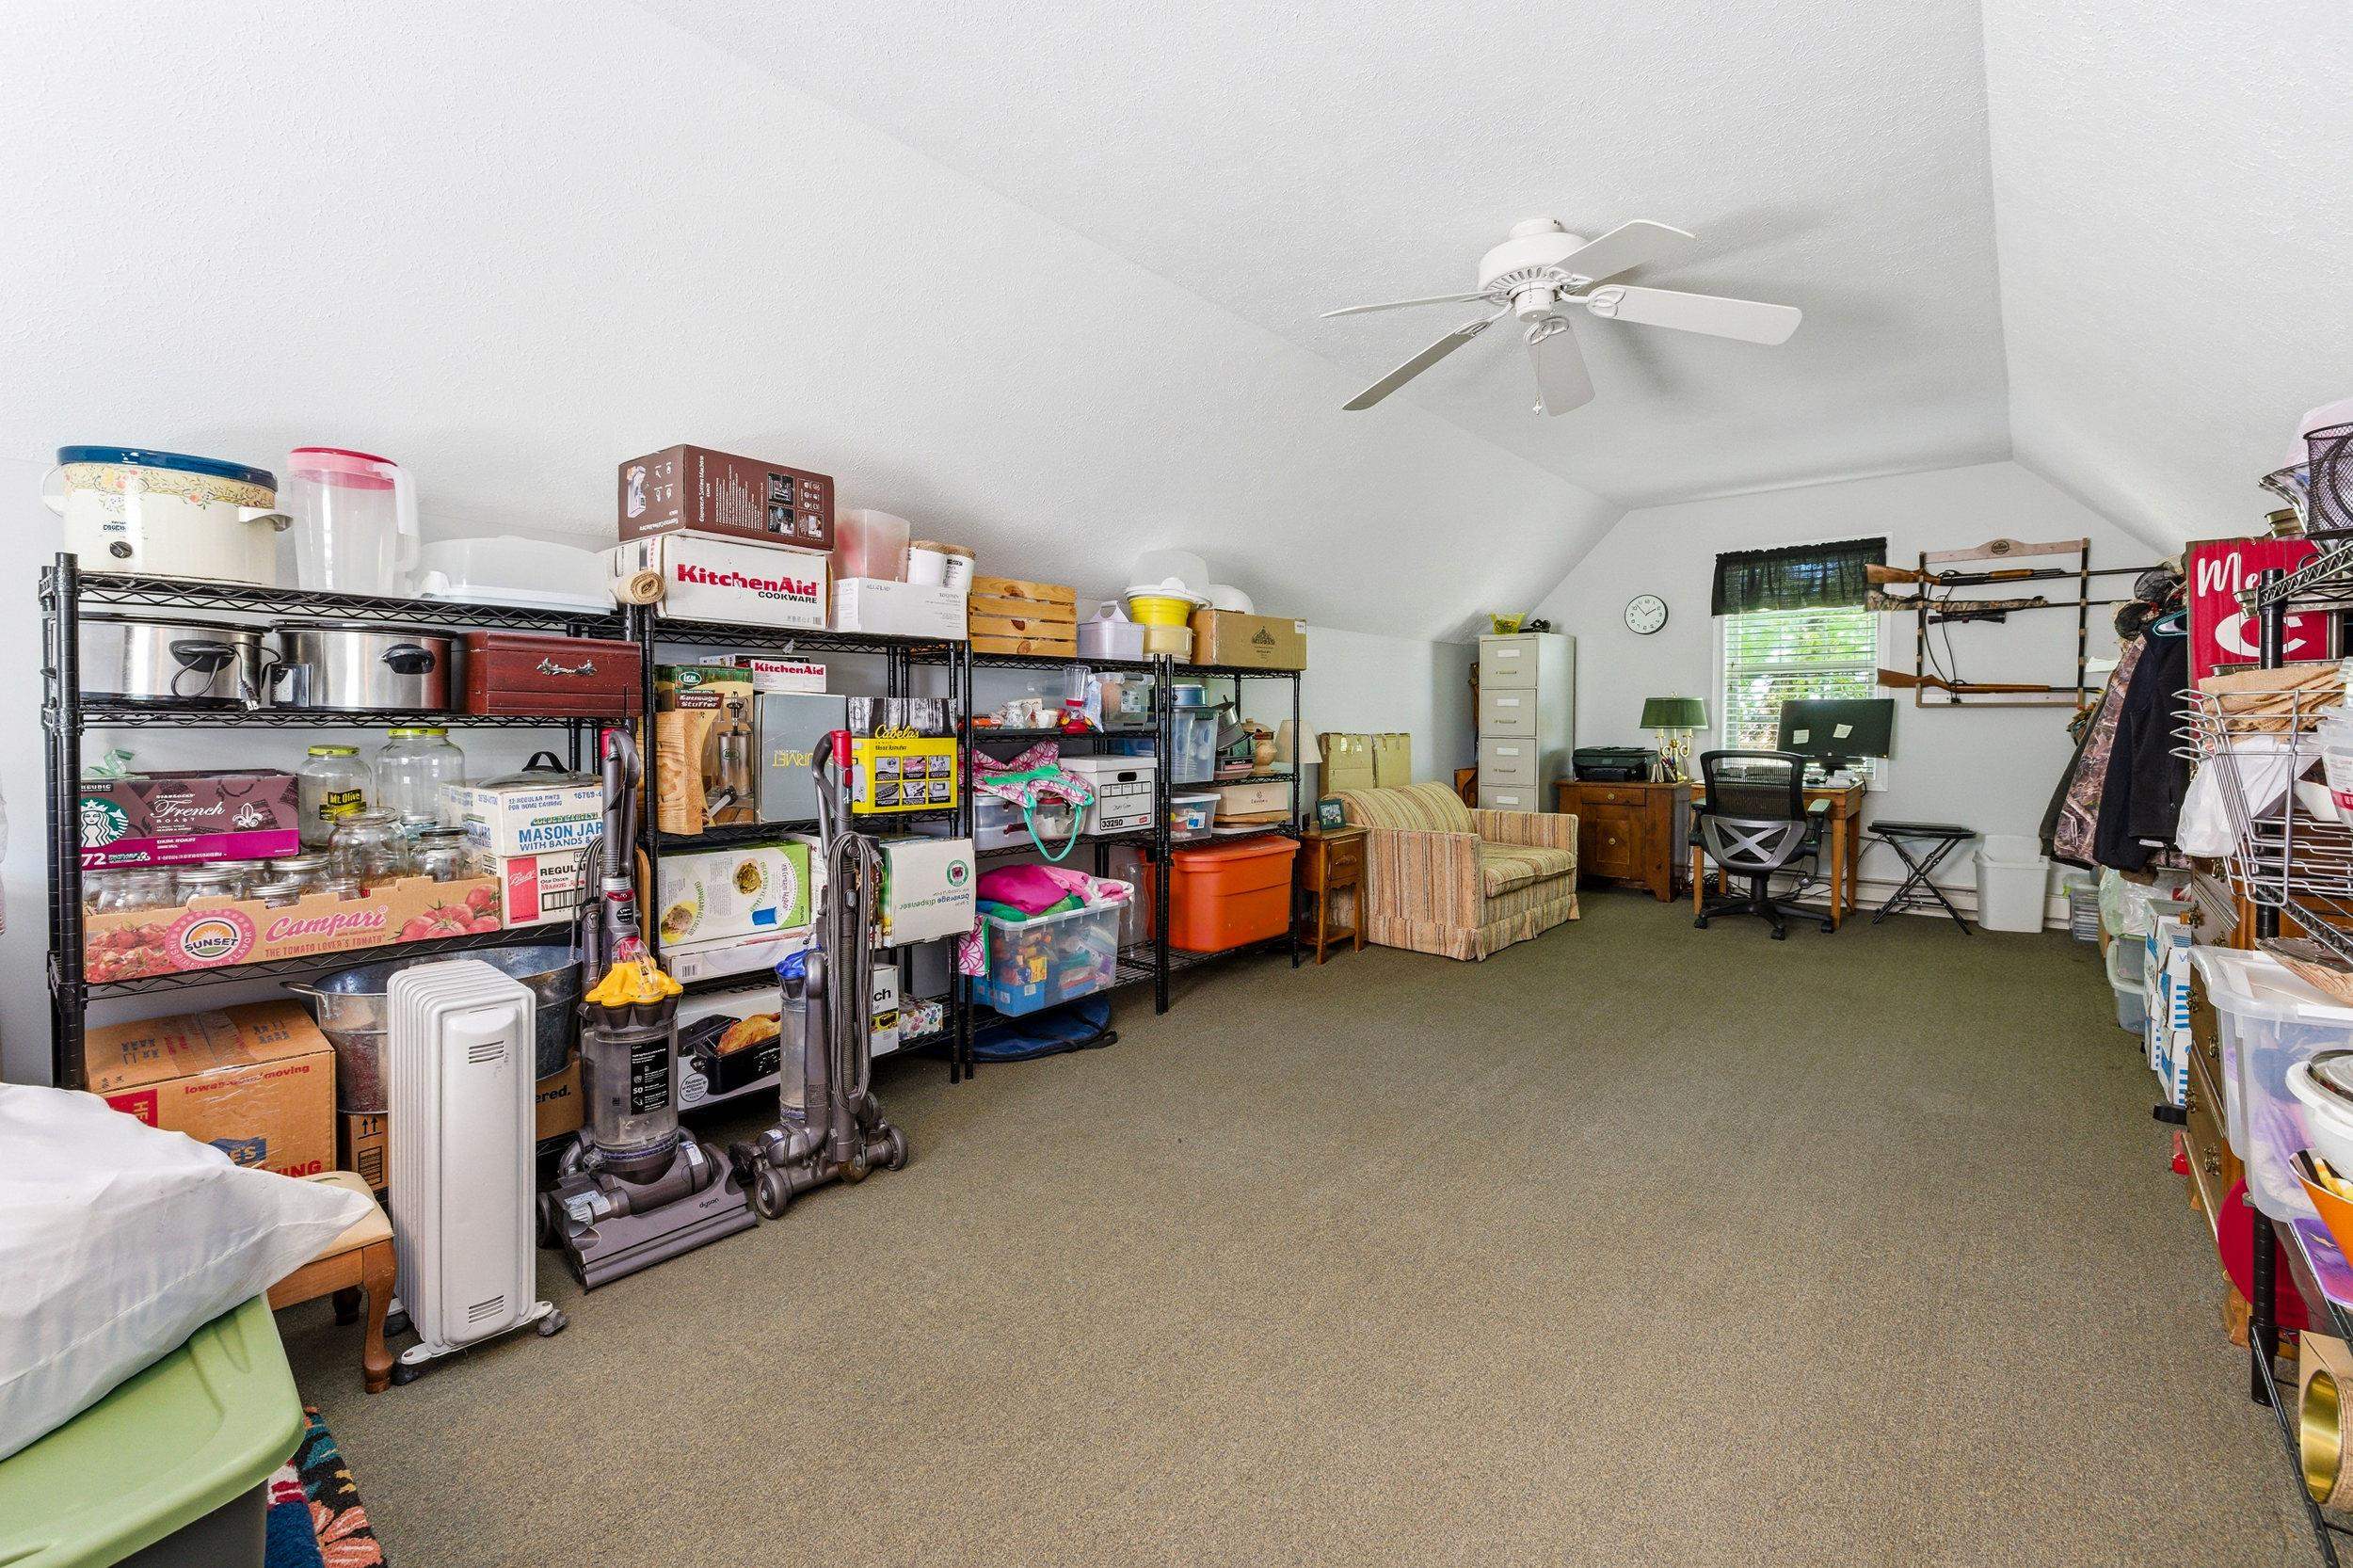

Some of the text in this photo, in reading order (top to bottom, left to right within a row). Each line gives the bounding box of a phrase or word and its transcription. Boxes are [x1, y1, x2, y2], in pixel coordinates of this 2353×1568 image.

[678, 563, 817, 598] KitchenAid
[758, 590, 817, 605] COOKWARE
[754, 662, 825, 675] KitchenAid
[874, 723, 920, 739] Cabela's
[342, 792, 360, 804] Olive
[150, 799, 226, 819] French
[519, 821, 604, 844] MASON JAR
[520, 840, 547, 853] WITH
[549, 836, 584, 848] BANDS
[81, 852, 106, 868] 72
[509, 871, 537, 887] Ball
[899, 898, 936, 910] dispenser
[264, 909, 384, 943] Campari
[184, 936, 239, 952] SUNSET
[264, 948, 280, 958] THE
[282, 943, 315, 955] TOMATO
[352, 934, 384, 948] TOMATO
[872, 988, 892, 1002] ch
[536, 1084, 571, 1103] ered.
[229, 1145, 257, 1162] ES
[698, 1197, 720, 1209] dyson
